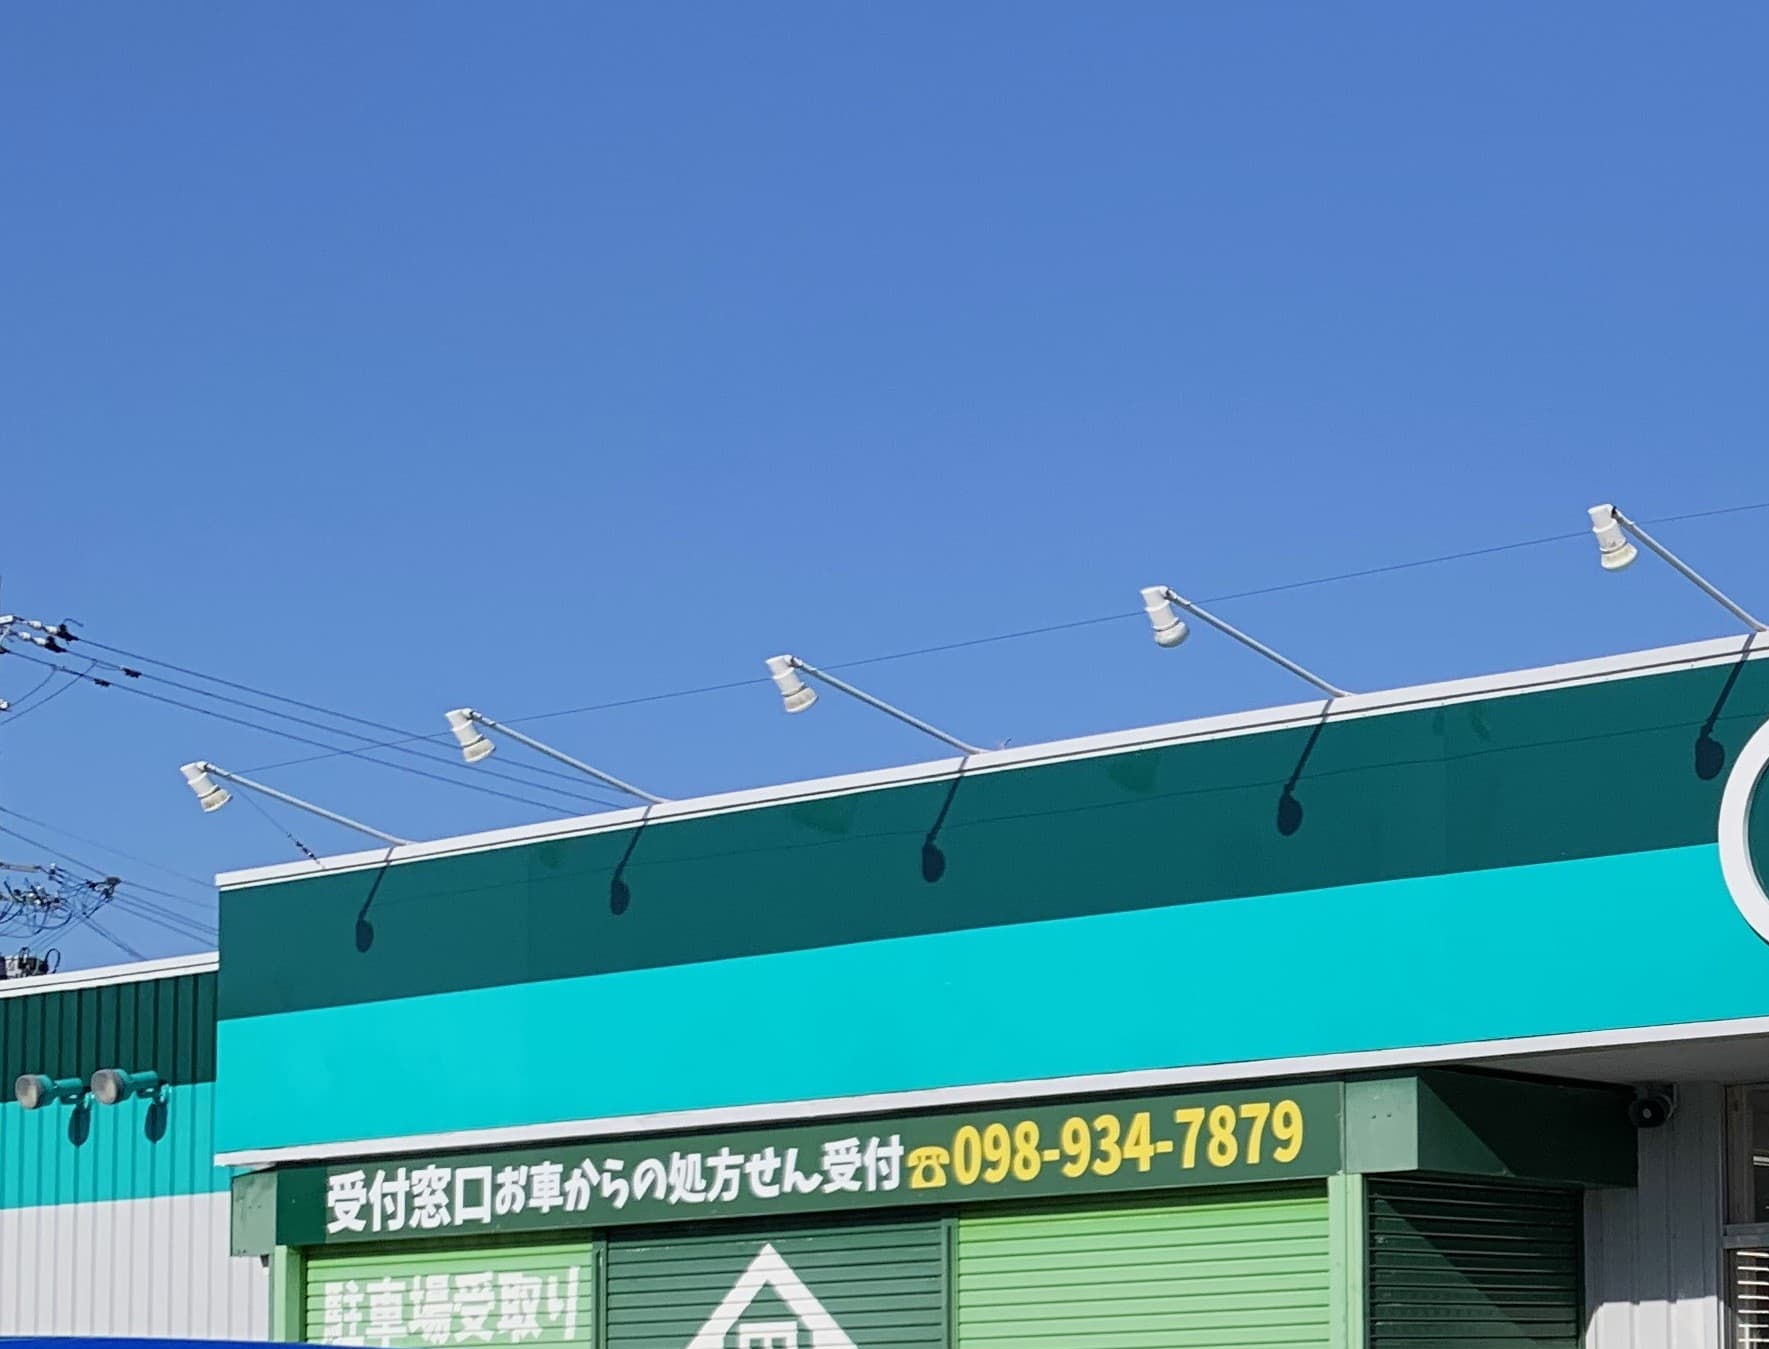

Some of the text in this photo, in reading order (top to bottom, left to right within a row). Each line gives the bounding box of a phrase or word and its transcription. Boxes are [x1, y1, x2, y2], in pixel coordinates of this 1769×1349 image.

[953, 1099, 1304, 1186] 098-934-7879
[321, 1266, 581, 1347] 駐車場受取り
